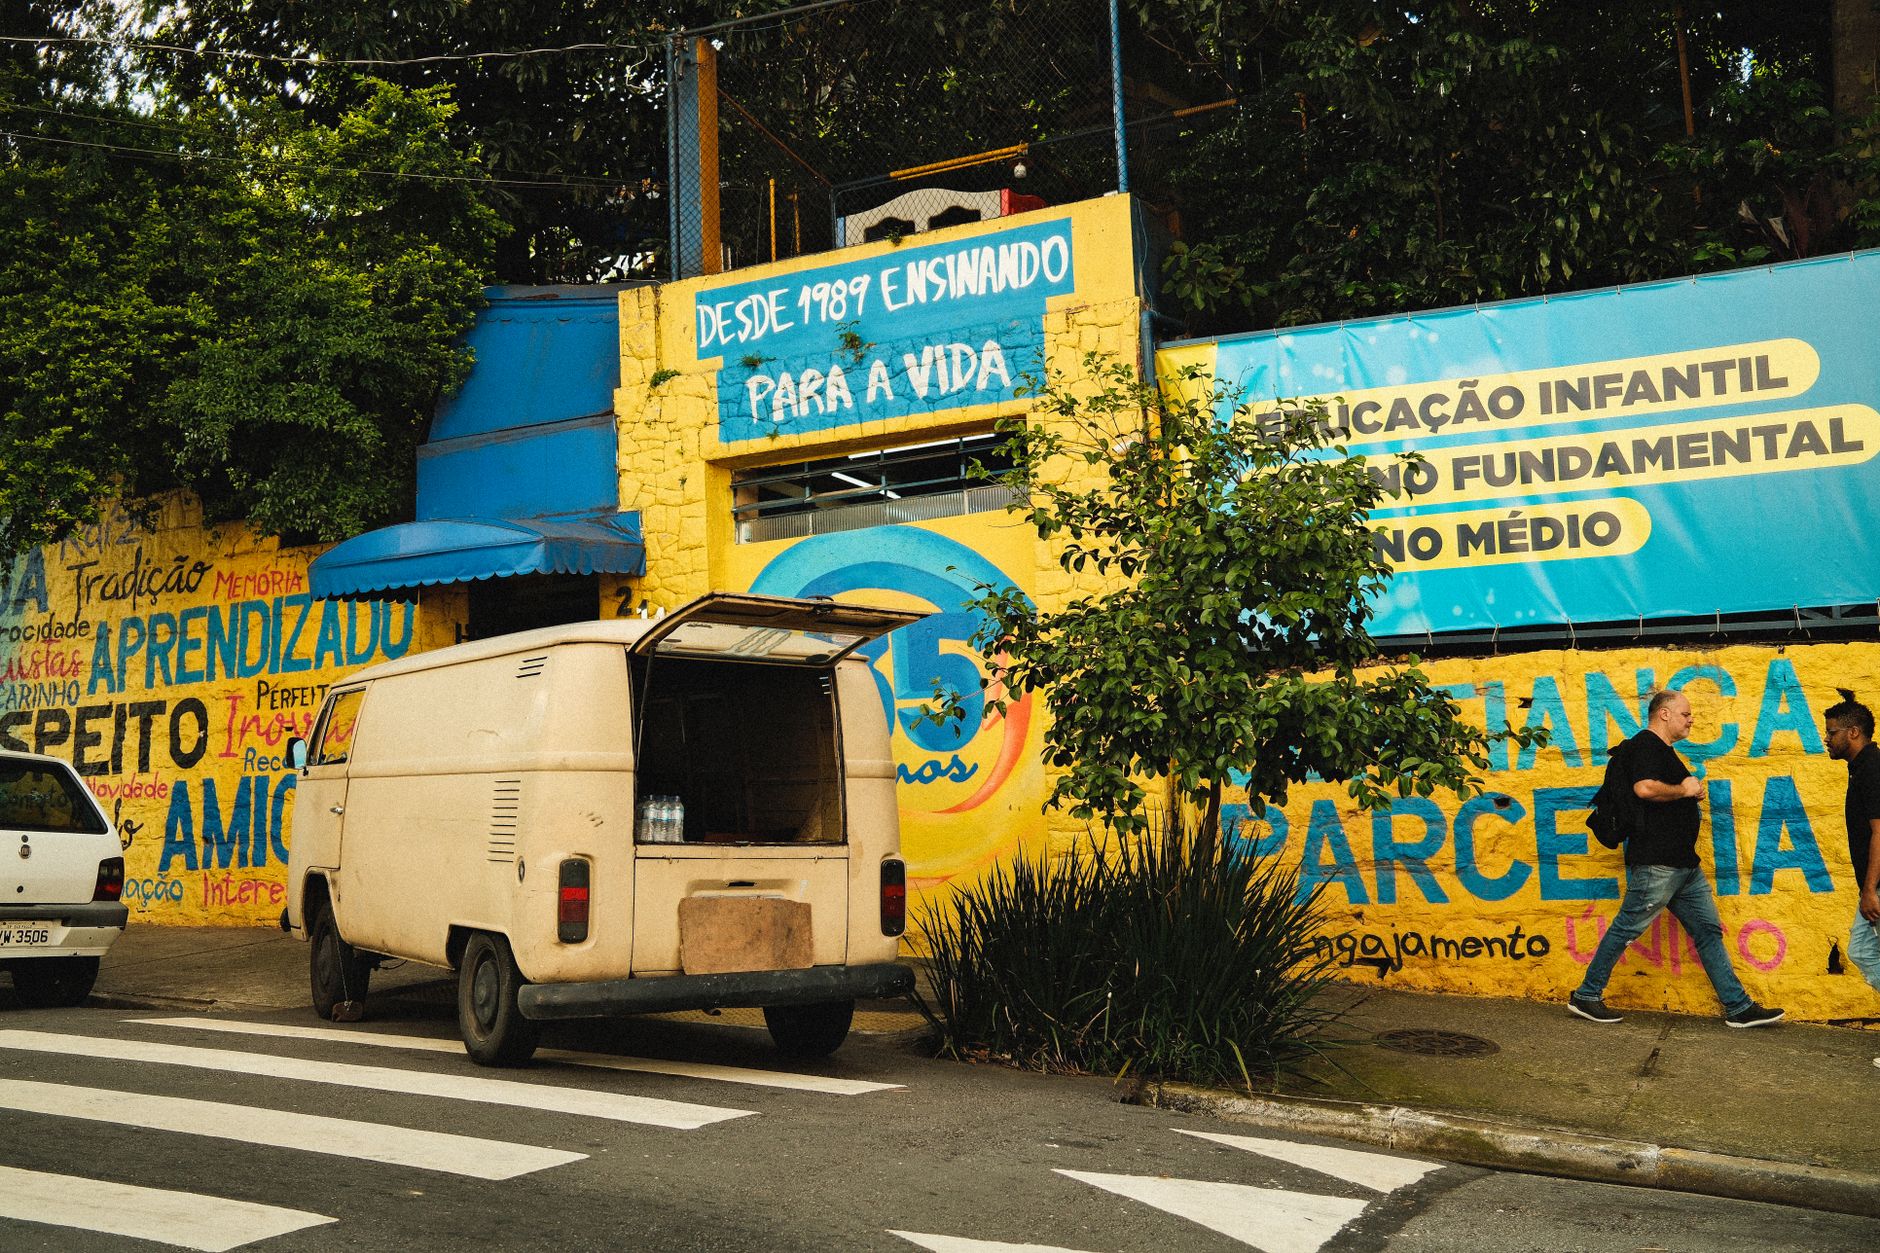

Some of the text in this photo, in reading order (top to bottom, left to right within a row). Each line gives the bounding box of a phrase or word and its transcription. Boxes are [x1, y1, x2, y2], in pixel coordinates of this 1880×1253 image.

[697, 234, 1069, 348] DESDE 1989 ENSINANDO
[745, 339, 1011, 424] PARA A VIDA
[1539, 354, 1788, 416] INFANTIL
[1452, 416, 1864, 492] FUNDAMENTAL
[1457, 509, 1621, 558] MÉDIO
[66, 546, 214, 622] Tradição
[213, 565, 302, 599] MEMÓRIA
[87, 593, 415, 695] APRENDIZADO
[257, 680, 330, 710] PERFEIT
[896, 754, 979, 785] nos
[1218, 776, 1835, 905] PARCEIA
[121, 873, 184, 907] ação
[204, 872, 289, 907] Intere
